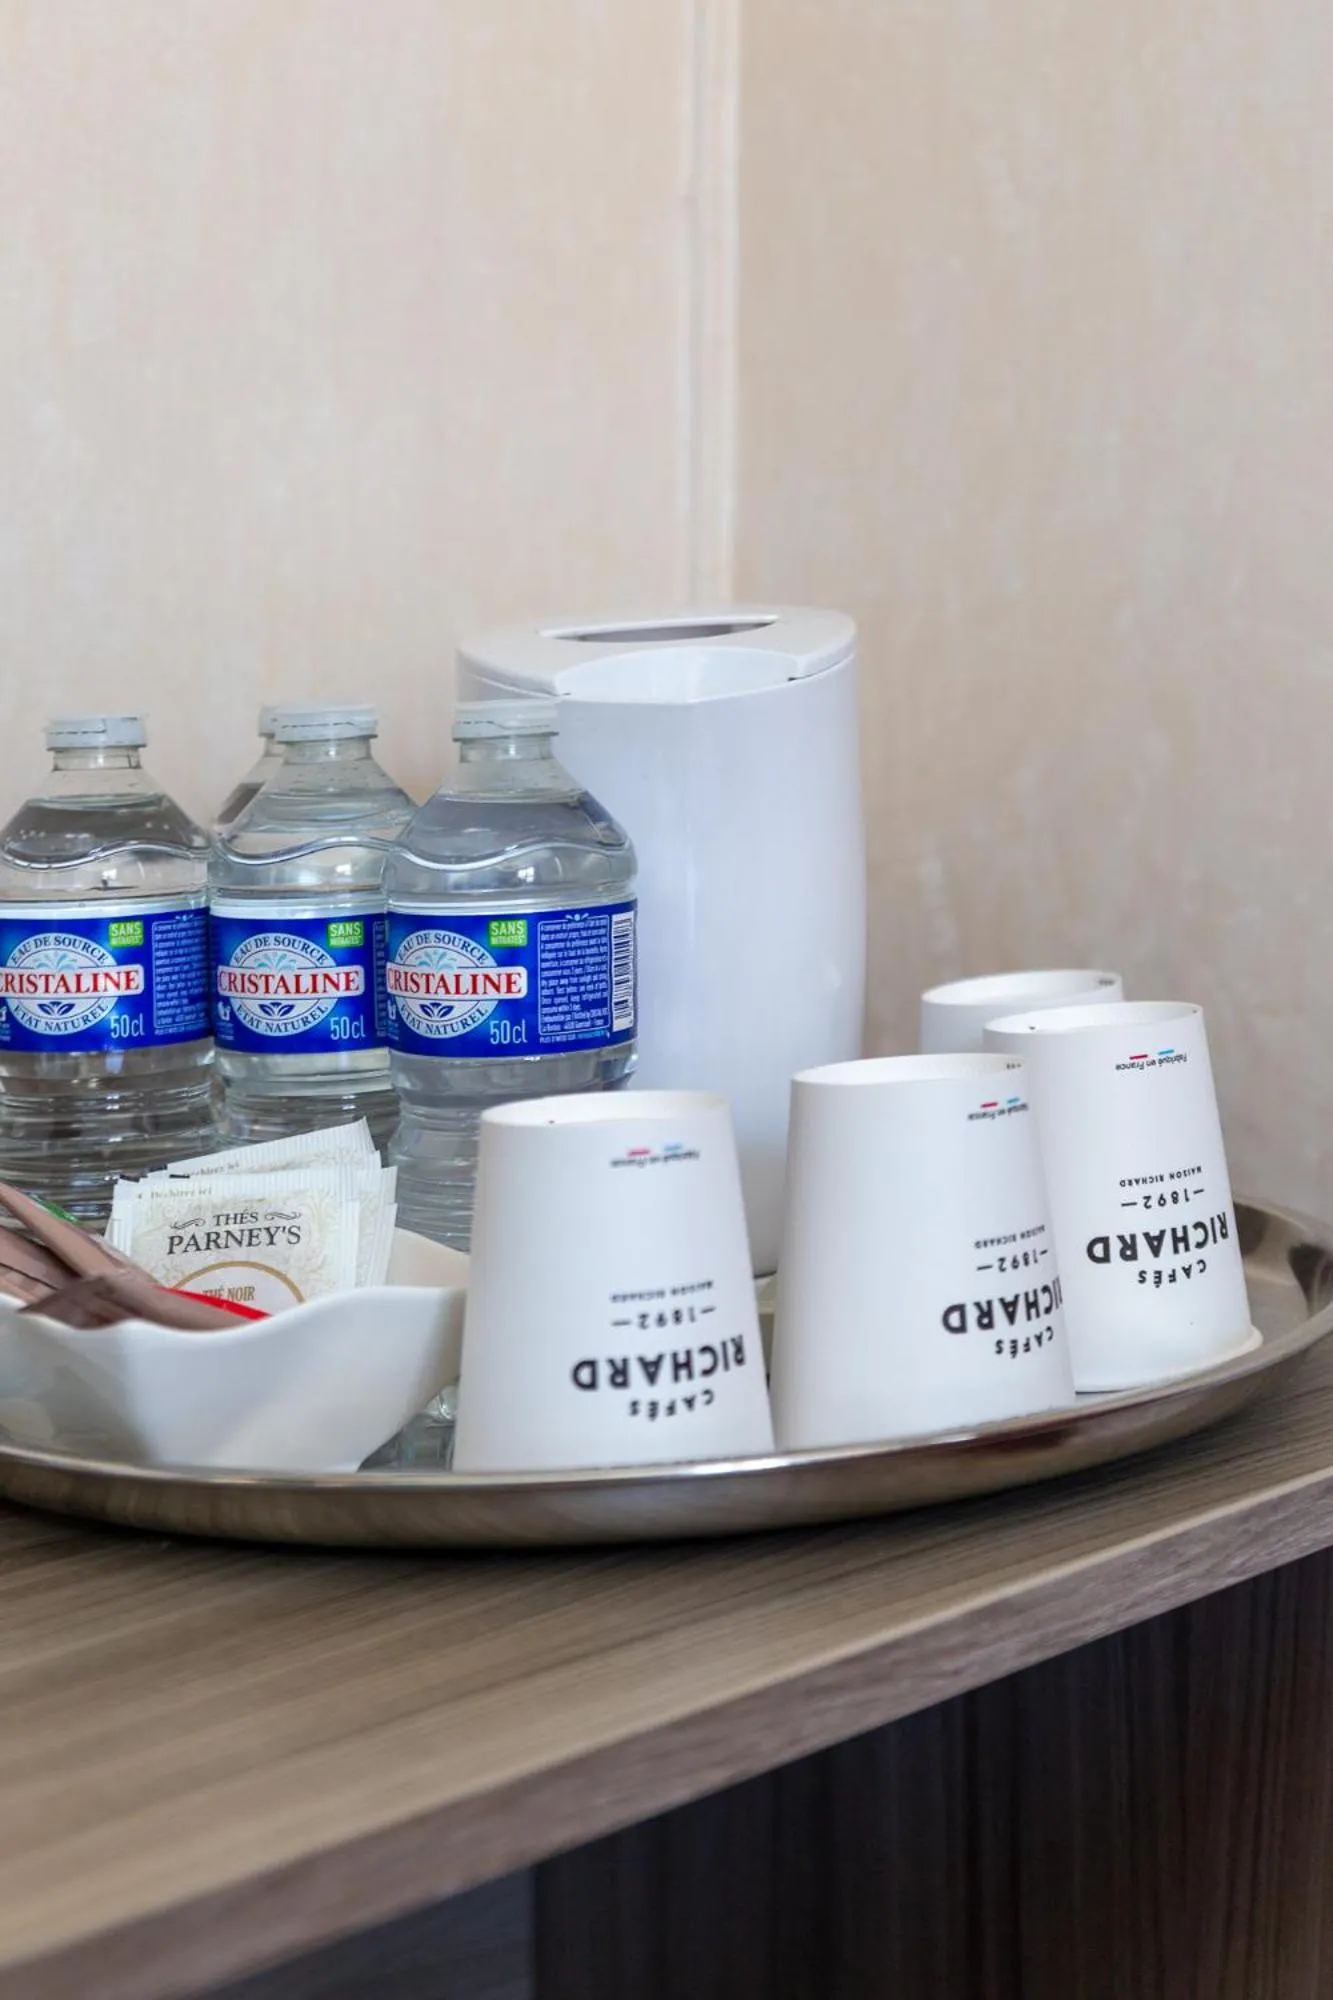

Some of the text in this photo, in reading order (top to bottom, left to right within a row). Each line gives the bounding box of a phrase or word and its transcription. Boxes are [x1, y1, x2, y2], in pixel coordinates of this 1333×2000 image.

[111, 921, 142, 936] SANS
[330, 922, 361, 936] SANS
[491, 921, 524, 935] SANS
[11, 942, 32, 964] EAU
[34, 936, 51, 949] DE
[53, 935, 109, 964] SOURCE
[234, 941, 252, 963] EAU
[254, 935, 271, 948] DE
[273, 935, 329, 965] SOURCE
[415, 933, 431, 945] DE
[434, 932, 488, 964] SOURCE
[219, 970, 360, 994] CRISTALINE
[387, 968, 522, 995] CRISTALINE
[44, 1004, 108, 1032] NATUREL
[264, 1005, 328, 1033] NATUREL
[425, 1008, 488, 1036] NATUREL
[1119, 1174, 1165, 1188] RICHARD
[213, 1209, 259, 1226] THÉS
[167, 1225, 302, 1255] PARNEY'S
[1085, 1211, 1229, 1265] RICHARD
[1137, 1259, 1207, 1289] CAFÉS
[227, 1286, 256, 1301] NOIR
[995, 1326, 1054, 1359] CAFÉS
[570, 1334, 746, 1392] RICHARD
[628, 1389, 715, 1421] CAFÉS
